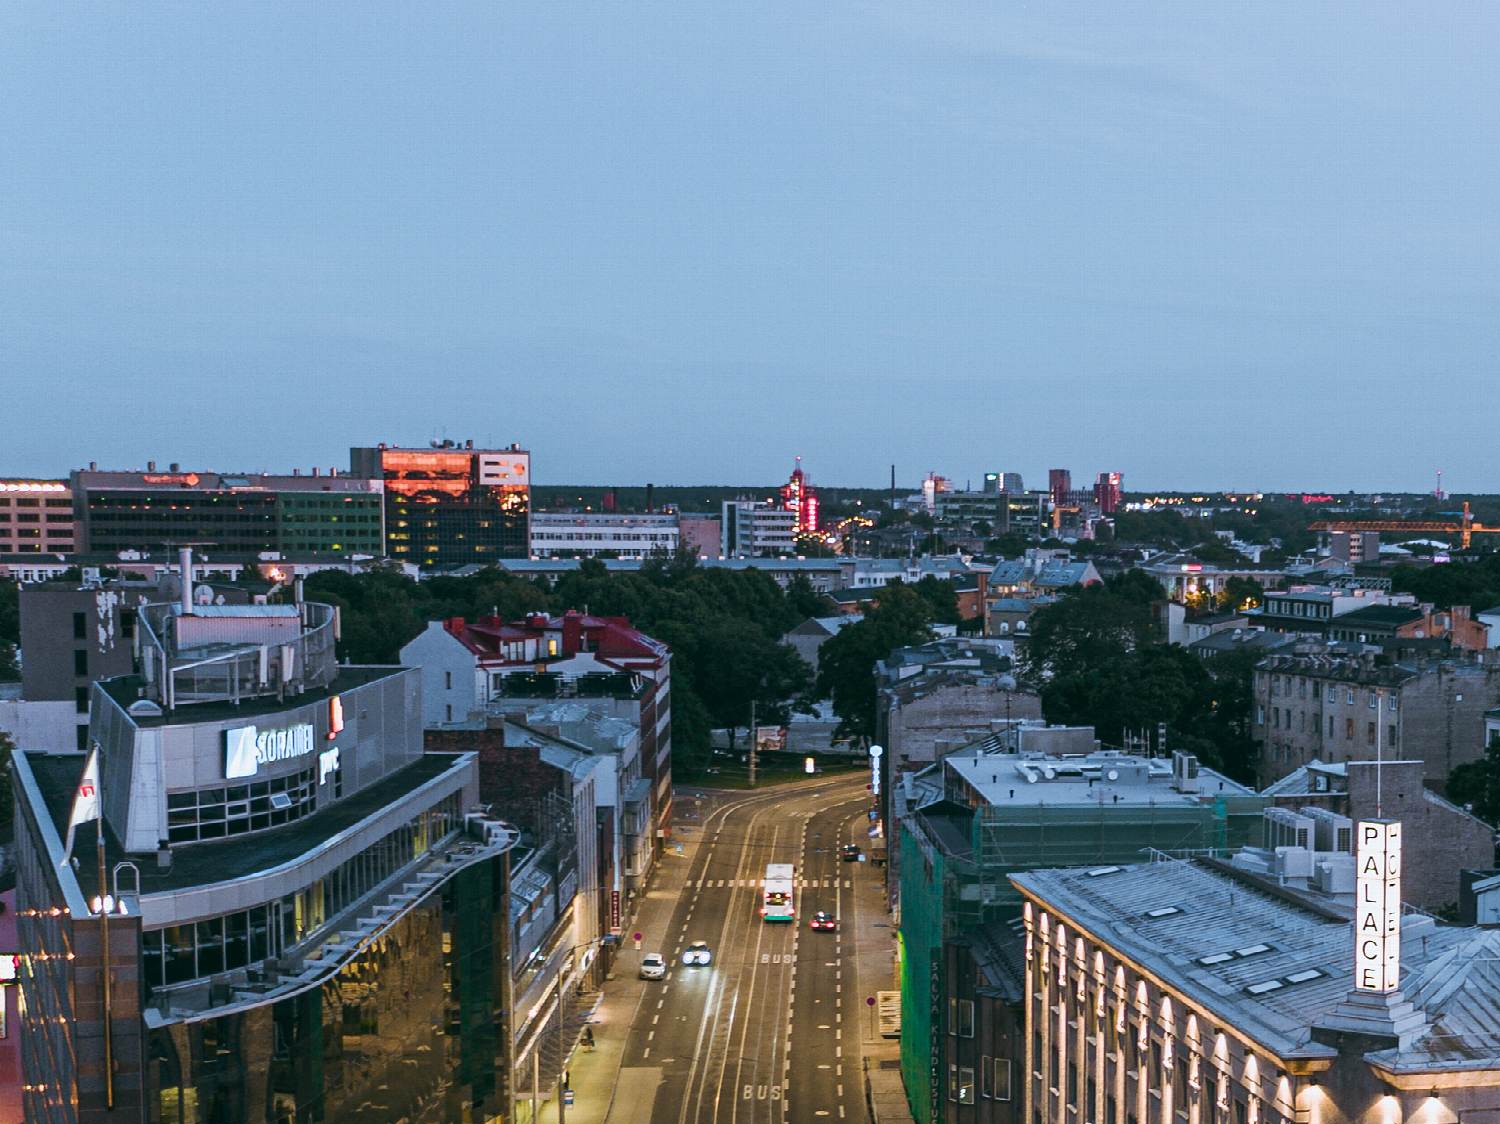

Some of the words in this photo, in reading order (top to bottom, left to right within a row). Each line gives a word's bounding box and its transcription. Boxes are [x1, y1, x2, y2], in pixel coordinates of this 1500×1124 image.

[1362, 827, 1379, 988] PALACE
[761, 953, 792, 964] BUS
[931, 962, 939, 1014] SALVA
[743, 1085, 782, 1100] BUS
